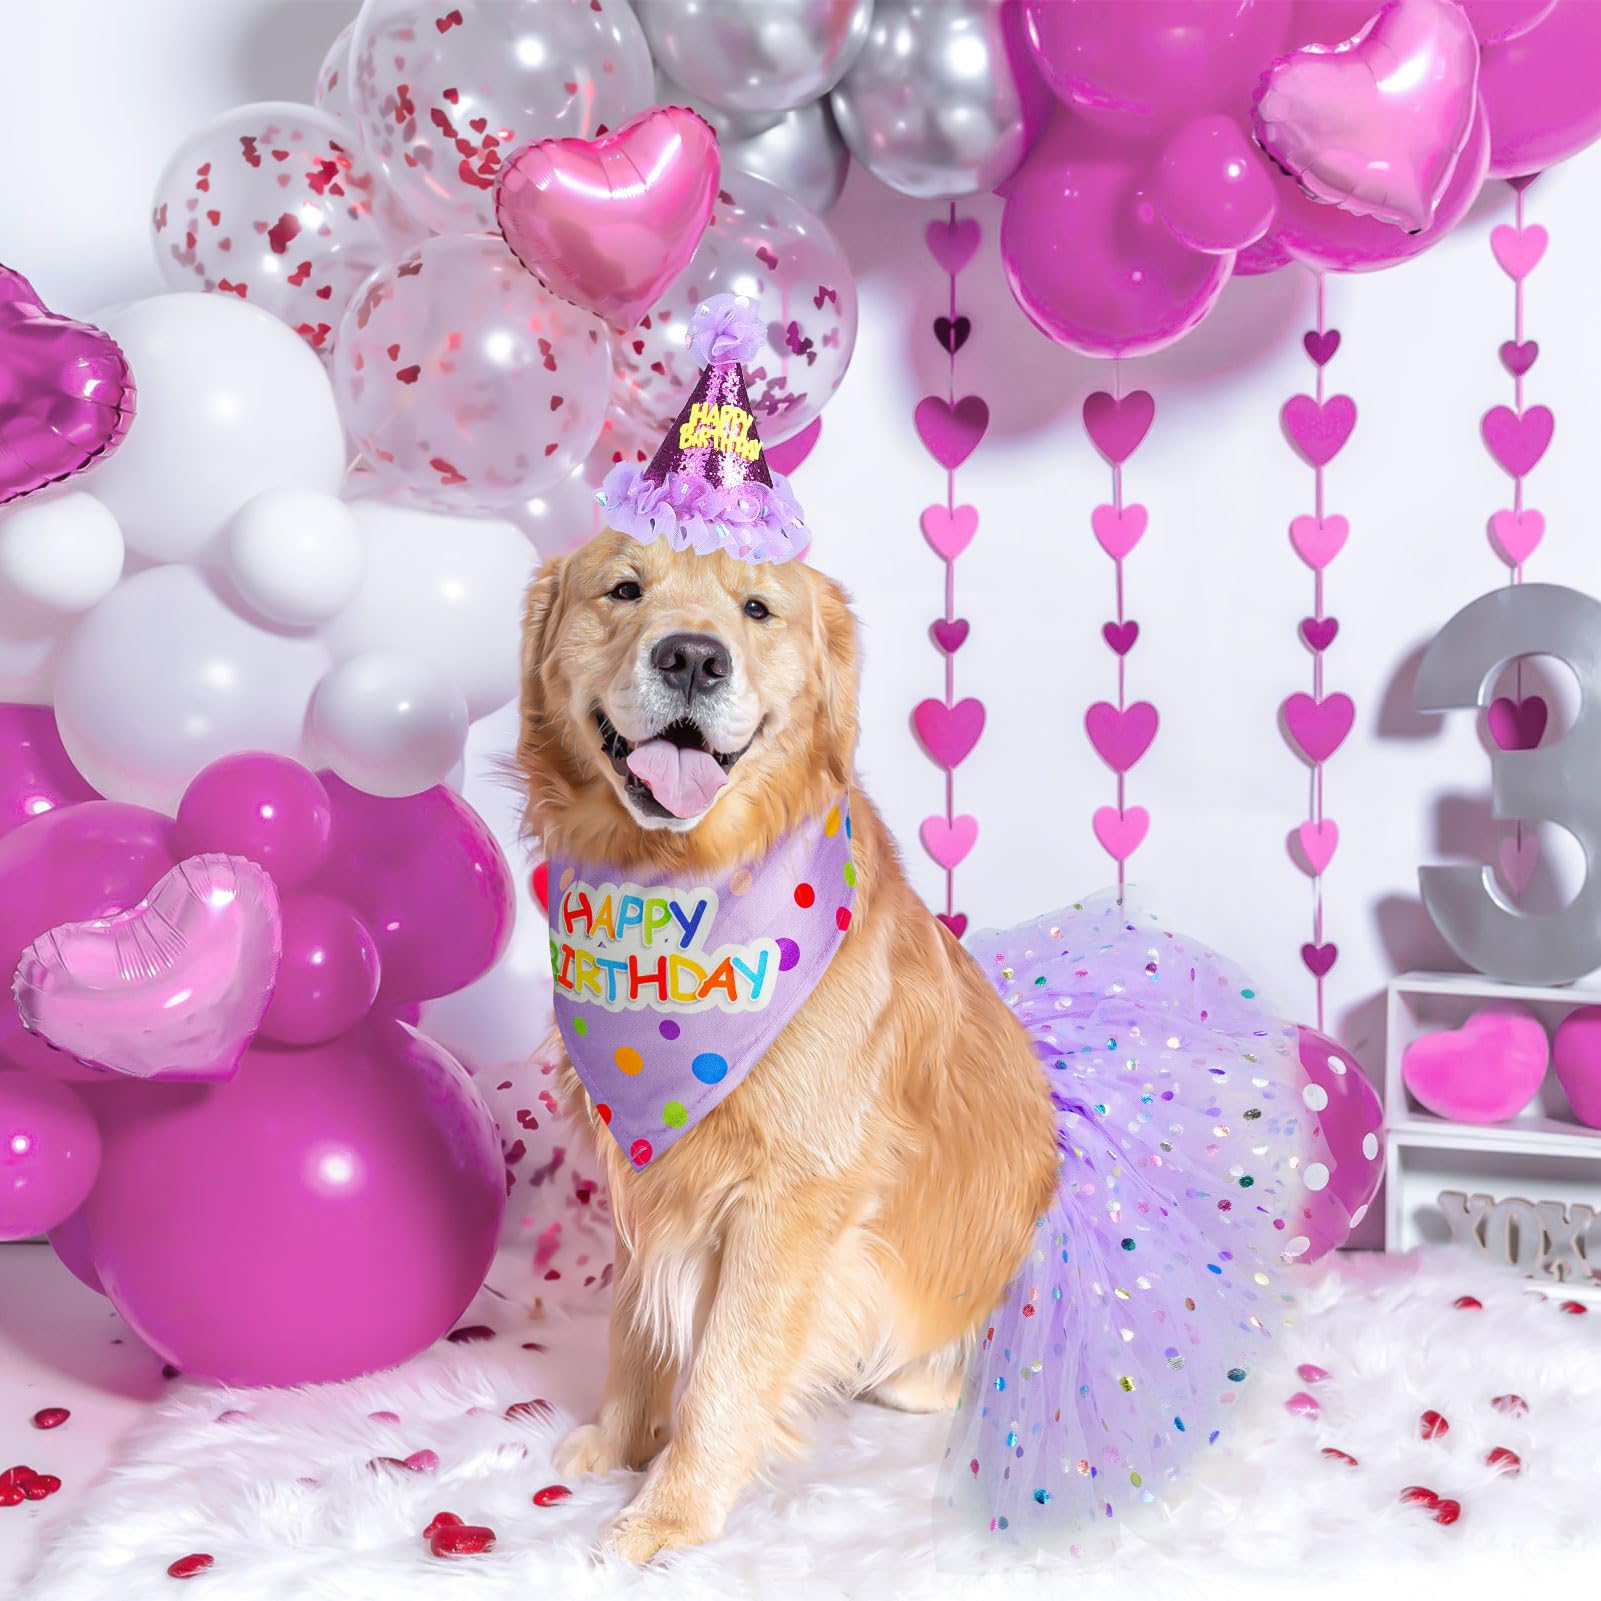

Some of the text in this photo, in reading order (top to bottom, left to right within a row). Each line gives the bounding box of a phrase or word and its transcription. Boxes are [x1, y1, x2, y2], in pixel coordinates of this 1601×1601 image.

[679, 423, 763, 461] BIRTHDAY
[688, 402, 754, 438] HAPPY
[1415, 583, 1601, 986] 3
[563, 891, 708, 949] HAPPY
[1438, 1190, 1601, 1286] XOX
